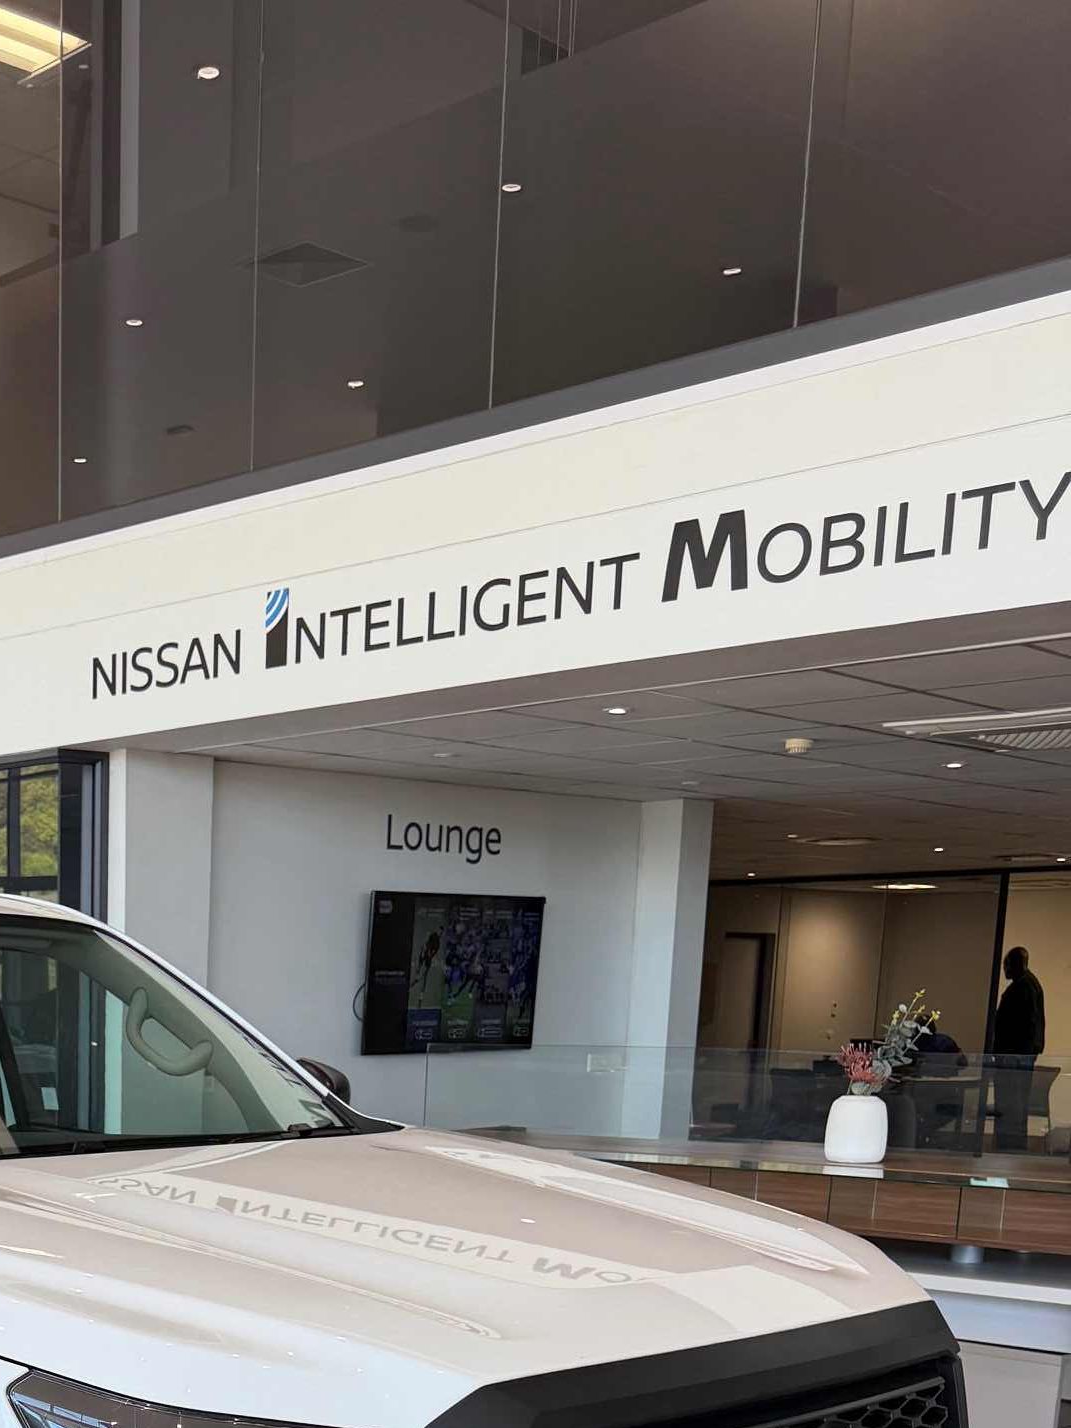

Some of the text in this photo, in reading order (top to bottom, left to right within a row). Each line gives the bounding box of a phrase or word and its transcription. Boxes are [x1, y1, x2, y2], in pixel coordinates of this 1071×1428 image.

[91, 471, 1071, 699] NISSAN INTELLIGENT MOBILITY
[386, 813, 503, 865] Lounge
